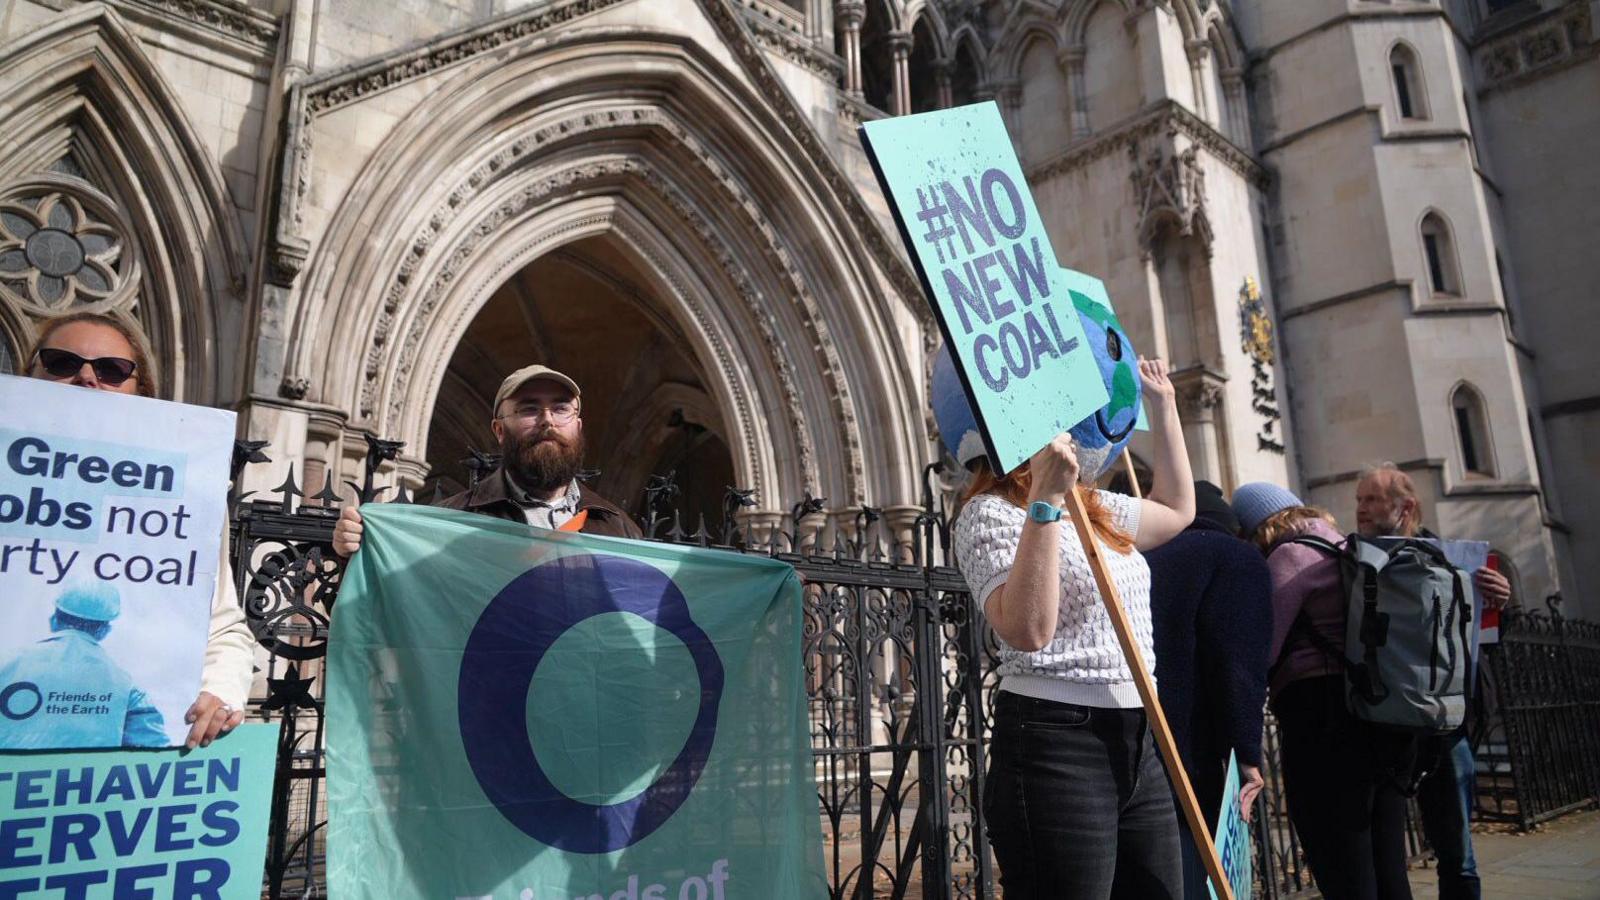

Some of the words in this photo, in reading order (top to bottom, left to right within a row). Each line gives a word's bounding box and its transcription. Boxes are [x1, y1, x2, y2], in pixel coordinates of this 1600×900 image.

[916, 168, 1026, 264] #NO
[941, 236, 1050, 335] NEW
[973, 302, 1079, 393] COAL
[7, 437, 174, 492] Green
[107, 505, 190, 539] not
[0, 538, 80, 584] rty
[94, 550, 197, 586] coal
[46, 704, 69, 714] the
[71, 704, 110, 715] Earth
[48, 692, 97, 702] Friends
[100, 692, 113, 702] of
[0, 757, 240, 810] EHAVEN
[0, 800, 240, 869] ERVES
